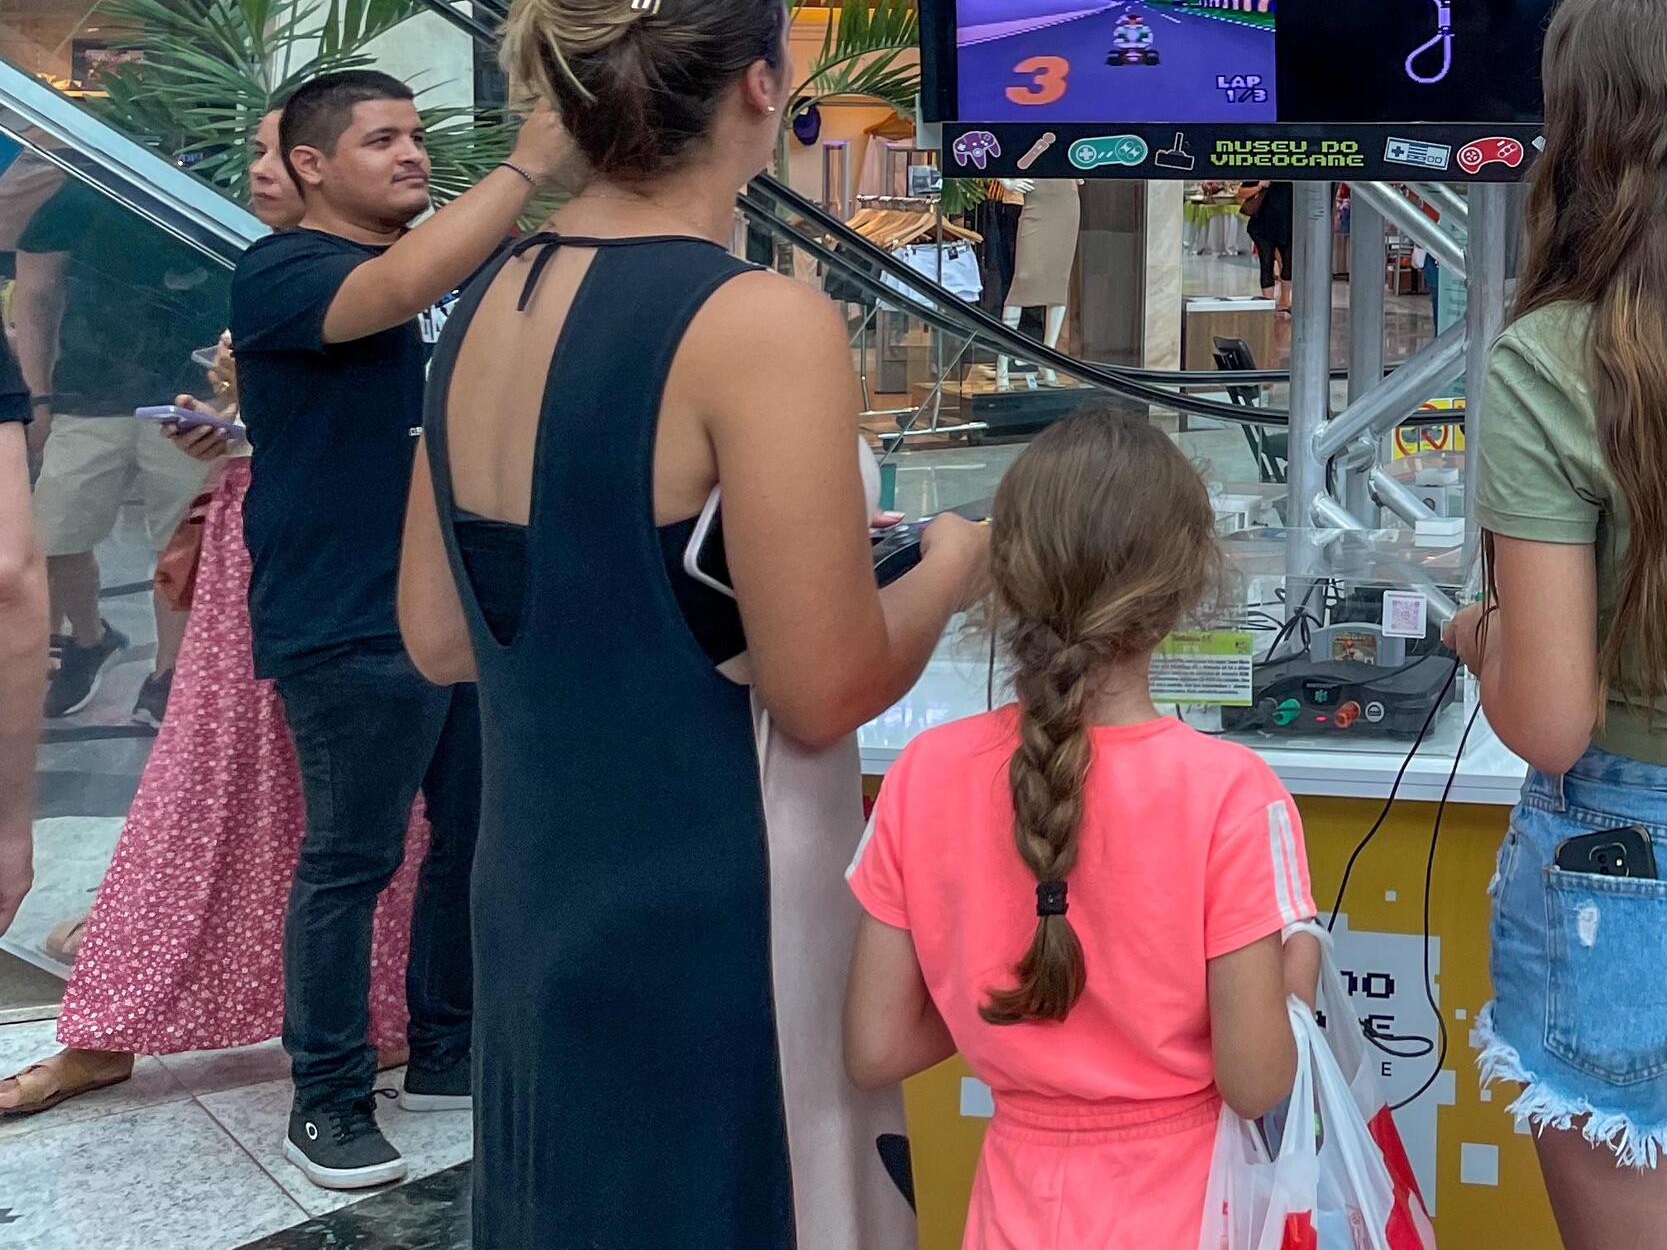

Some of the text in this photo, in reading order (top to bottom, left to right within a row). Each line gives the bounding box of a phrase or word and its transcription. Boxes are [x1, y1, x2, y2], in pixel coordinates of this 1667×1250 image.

[1004, 55, 1070, 107] 3
[1216, 74, 1262, 89] LAP
[1226, 88, 1268, 103] 1/3
[1216, 140, 1359, 153] MUSEU DO
[1210, 154, 1364, 167] VIDEOGAME
